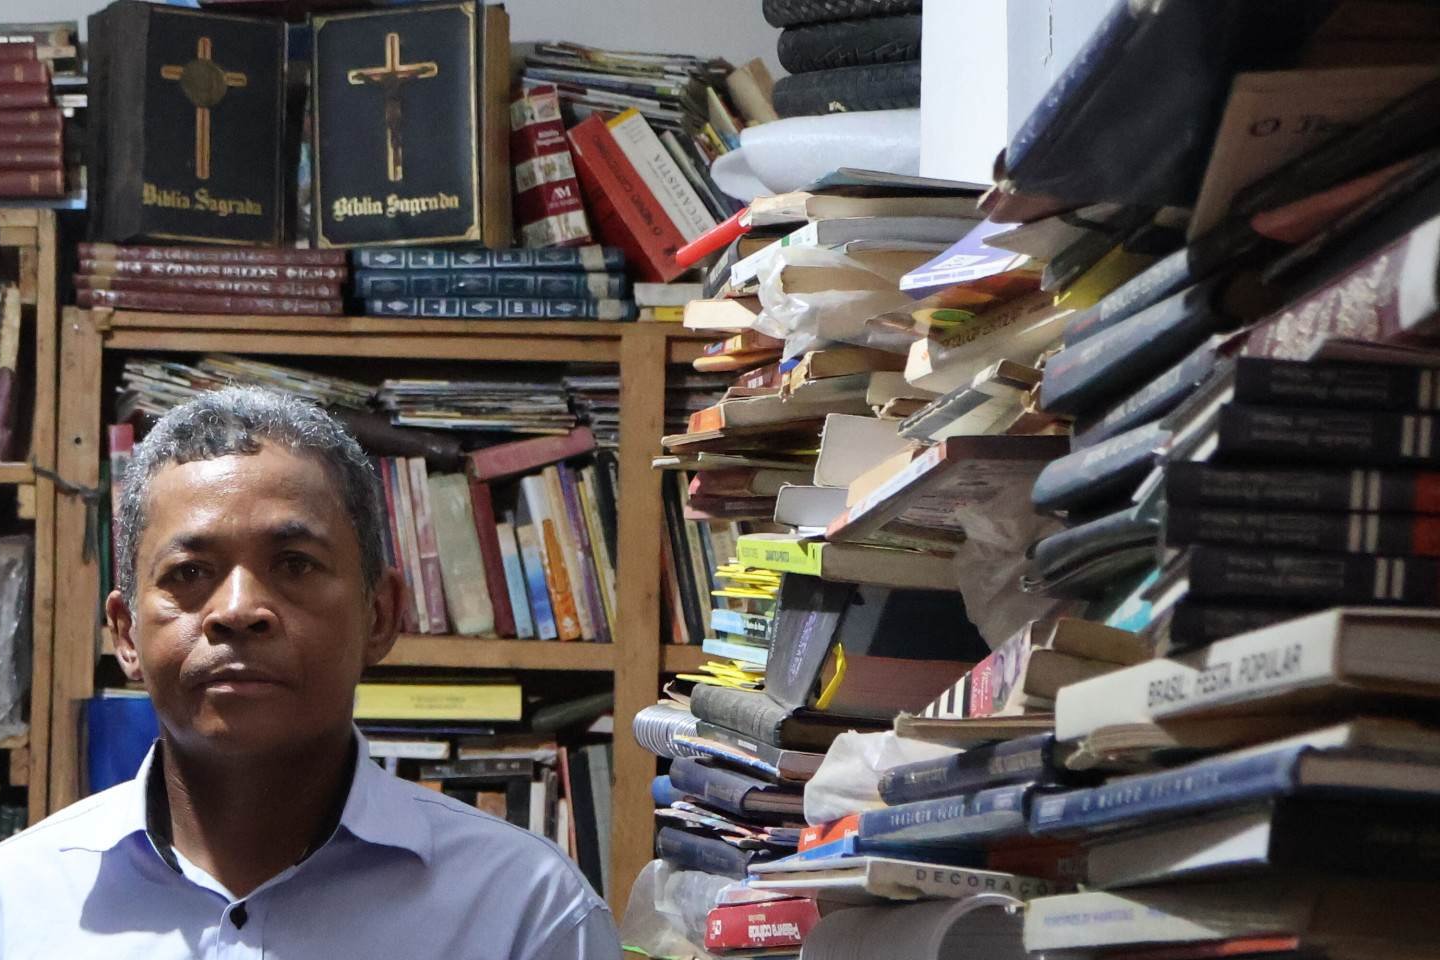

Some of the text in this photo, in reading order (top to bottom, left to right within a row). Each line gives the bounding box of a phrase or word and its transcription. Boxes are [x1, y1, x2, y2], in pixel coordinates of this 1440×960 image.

[195, 187, 262, 216] Sagrada
[386, 192, 459, 218] Sagrada
[1147, 678, 1187, 708] BRASIL
[1237, 643, 1303, 686] POPULAR
[747, 922, 801, 942] Palavra colhida
